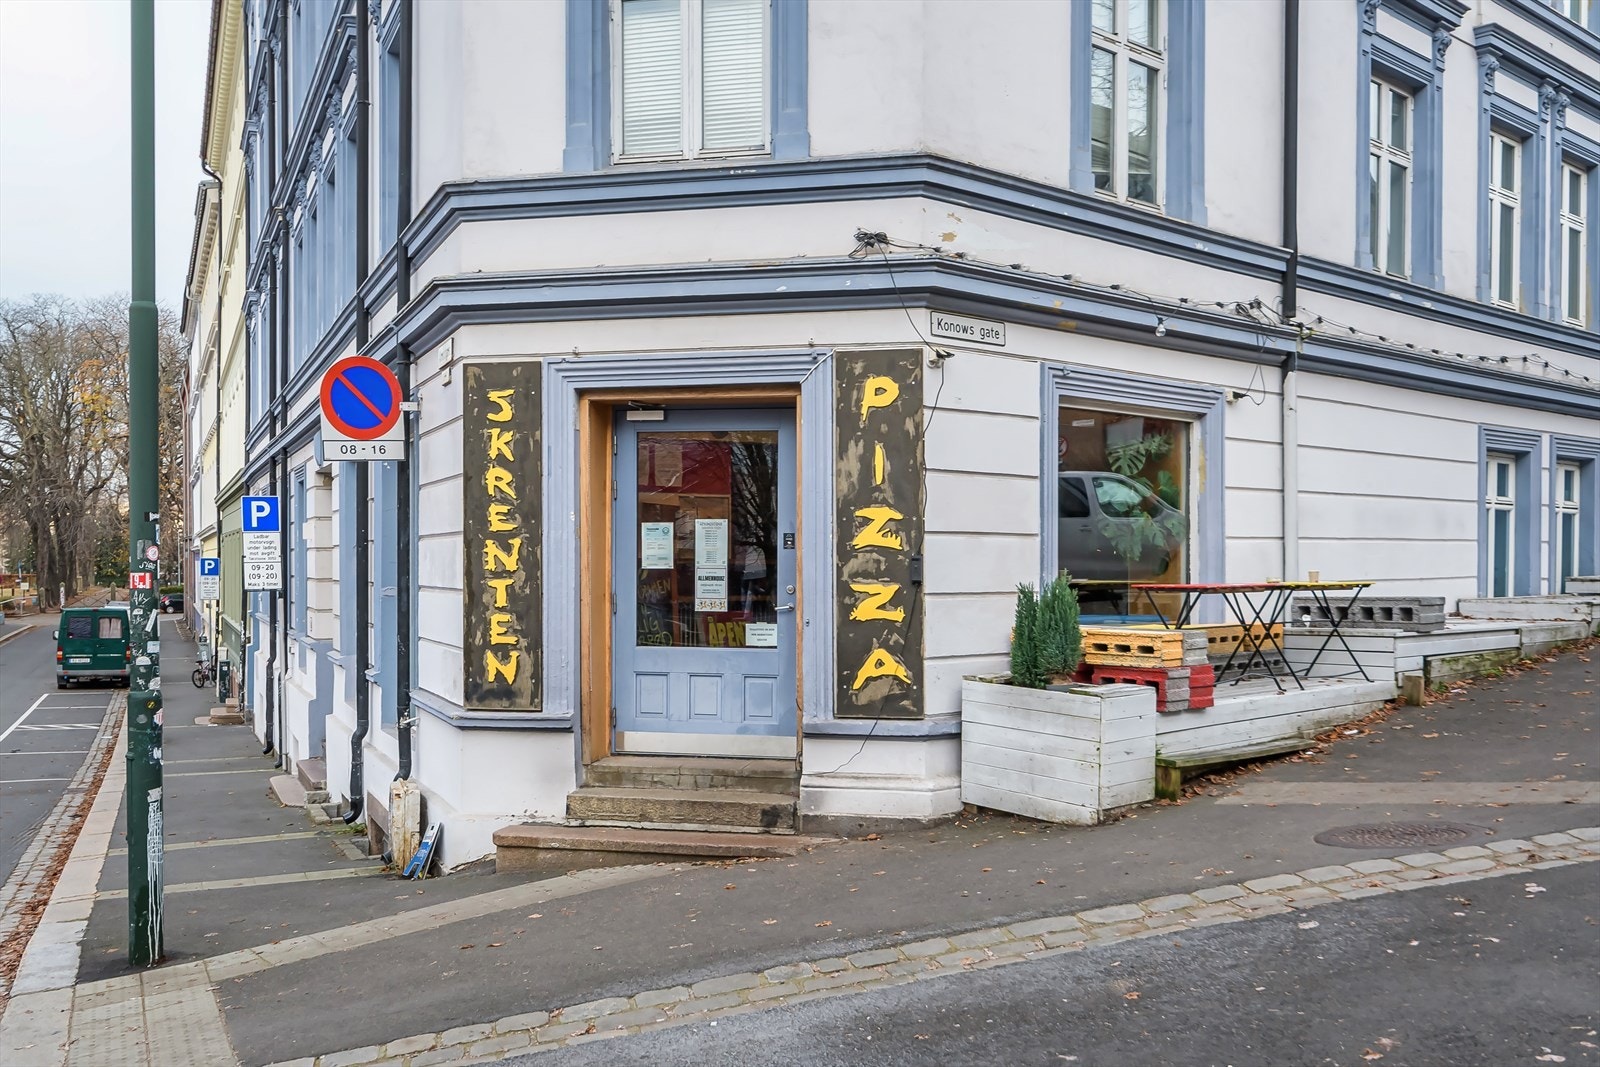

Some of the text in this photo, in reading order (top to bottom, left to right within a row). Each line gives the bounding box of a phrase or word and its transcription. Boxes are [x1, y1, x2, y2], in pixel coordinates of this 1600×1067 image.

[937, 318, 1000, 340] Konows gate
[250, 500, 271, 528] P
[483, 388, 522, 685] SKRENTEN
[850, 376, 912, 690] PIZZA
[204, 560, 216, 574] P
[709, 616, 746, 647] ÅPEN
